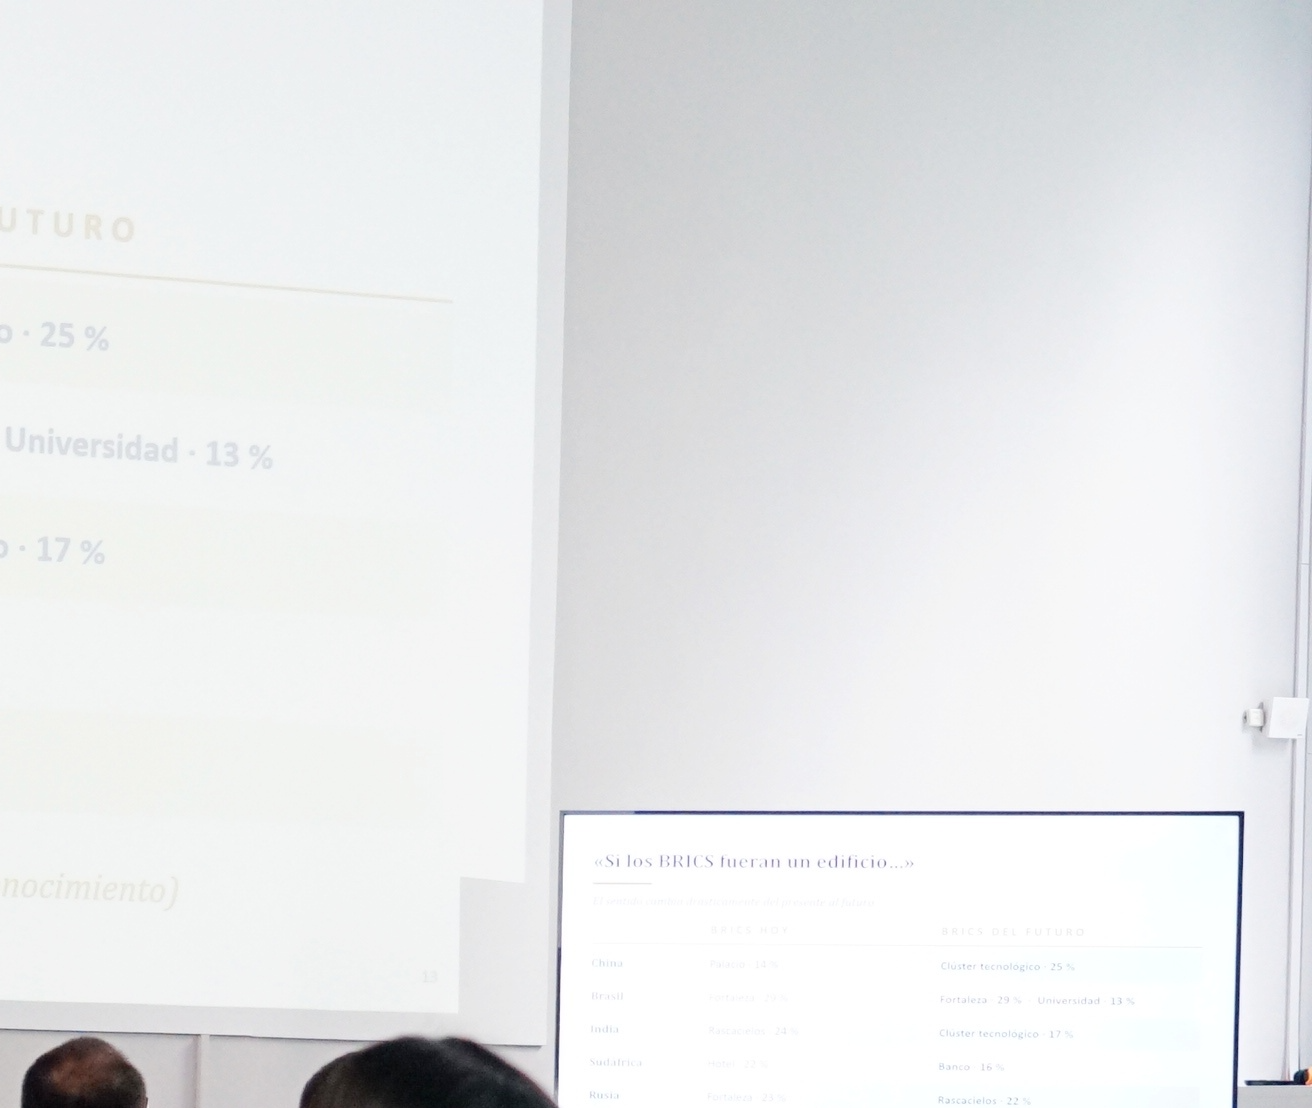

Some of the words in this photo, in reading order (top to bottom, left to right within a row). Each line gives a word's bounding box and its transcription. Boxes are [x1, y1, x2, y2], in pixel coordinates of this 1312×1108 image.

[39, 320, 76, 349] 25
[83, 324, 110, 352] %
[4, 425, 179, 464] Universidad
[206, 440, 240, 468] 13
[247, 443, 274, 471] %
[36, 535, 72, 563] 17
[79, 539, 106, 566] %
[594, 853, 622, 869] «Si
[626, 853, 653, 869] los
[659, 853, 715, 869] BRICS
[720, 853, 782, 869] fueran
[787, 856, 812, 869] un
[816, 853, 916, 869] edificio...»
[940, 926, 983, 936] BRICS
[991, 926, 1016, 936] DEL
[1024, 926, 1085, 937] FUTURO
[590, 957, 623, 968] China
[939, 960, 977, 971] Clúster
[979, 961, 1041, 974] tecnológico
[1049, 961, 1063, 972] 25
[590, 991, 624, 1001] Brasil
[939, 994, 988, 1005] Fortaleza
[996, 995, 1010, 1005] 29
[1036, 996, 1100, 1005] Universidad
[1110, 996, 1123, 1006] 13
[589, 1024, 619, 1034] India
[938, 1028, 975, 1038] Clúster
[977, 1029, 1040, 1040] tecnológico
[1048, 1029, 1061, 1039] 17
[588, 1057, 643, 1067] Sudáfrica
[937, 1061, 971, 1071] Banco
[980, 1062, 993, 1071] 16
[588, 1090, 620, 1100] Rusia
[936, 1094, 997, 1106] Rascacielos
[1005, 1095, 1019, 1106] 22
